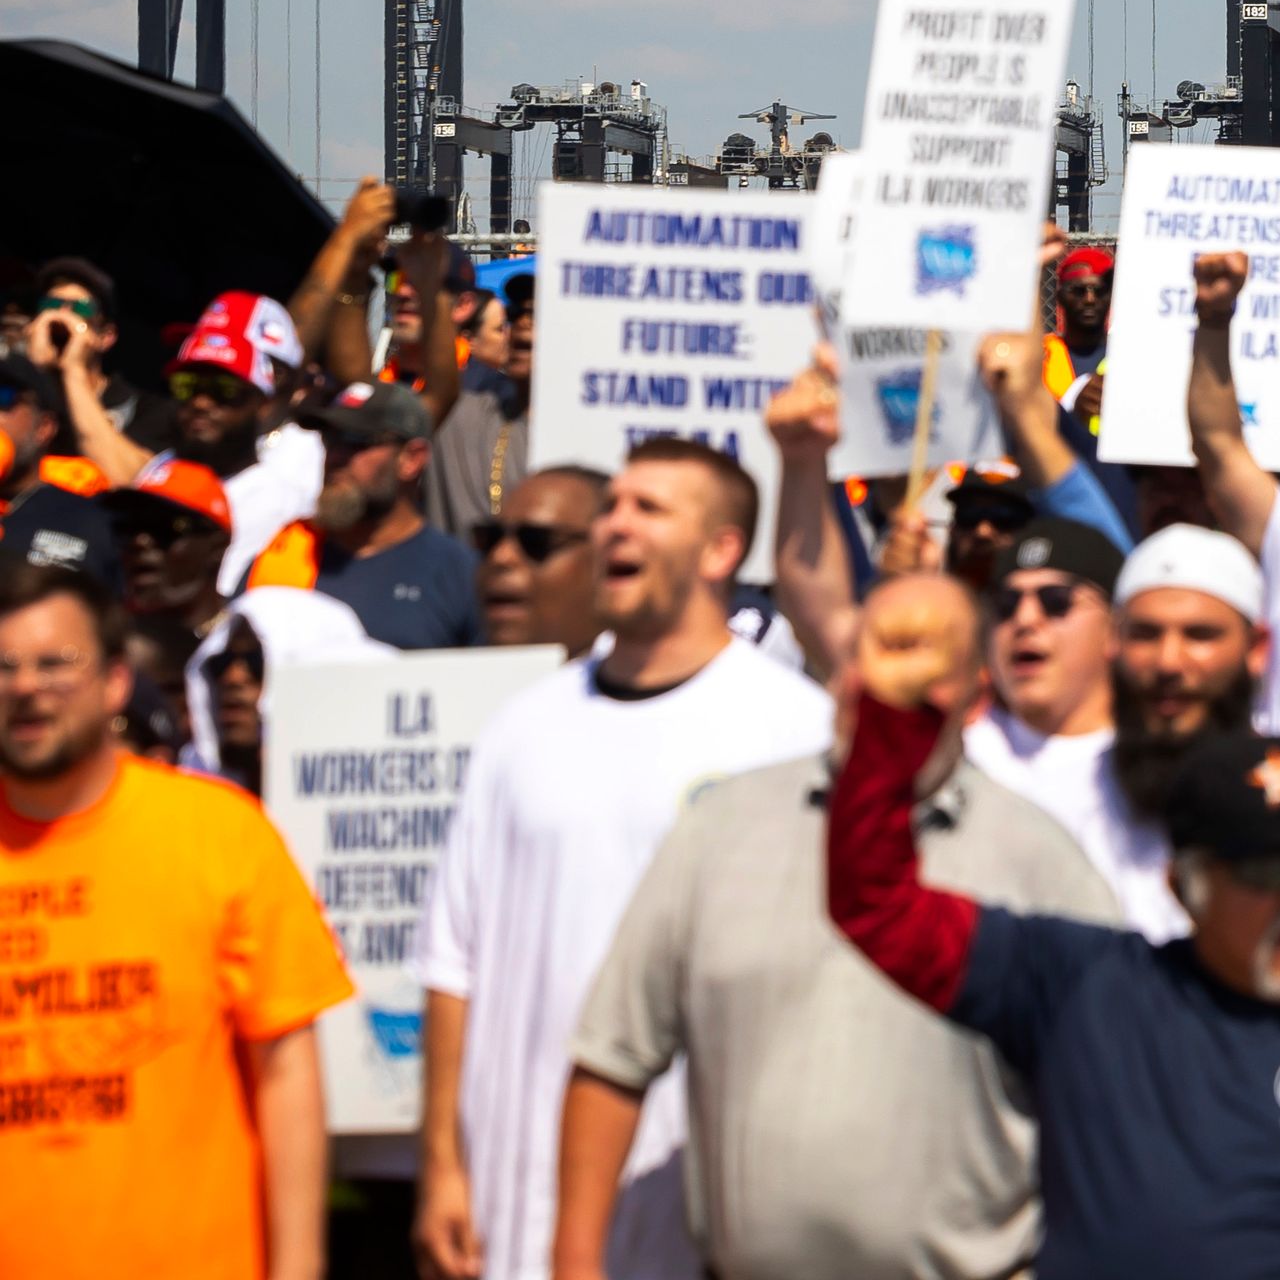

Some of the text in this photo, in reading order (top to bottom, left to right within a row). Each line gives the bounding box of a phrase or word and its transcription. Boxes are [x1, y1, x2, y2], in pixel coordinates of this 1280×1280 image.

[904, 9, 1047, 44] PROFIT OVER
[1245, 6, 1265, 17] 182
[915, 50, 996, 83] PEOPLE
[910, 134, 1011, 168] SUPPORT
[922, 177, 1030, 213] WORKERS
[583, 209, 800, 251] AUTOMATION
[561, 262, 743, 305] THREATENS
[1240, 332, 1280, 360] ILA
[581, 370, 688, 406] STAND
[388, 689, 436, 737] ILA
[293, 748, 437, 800] WORKERS
[326, 806, 457, 851] MACHIN
